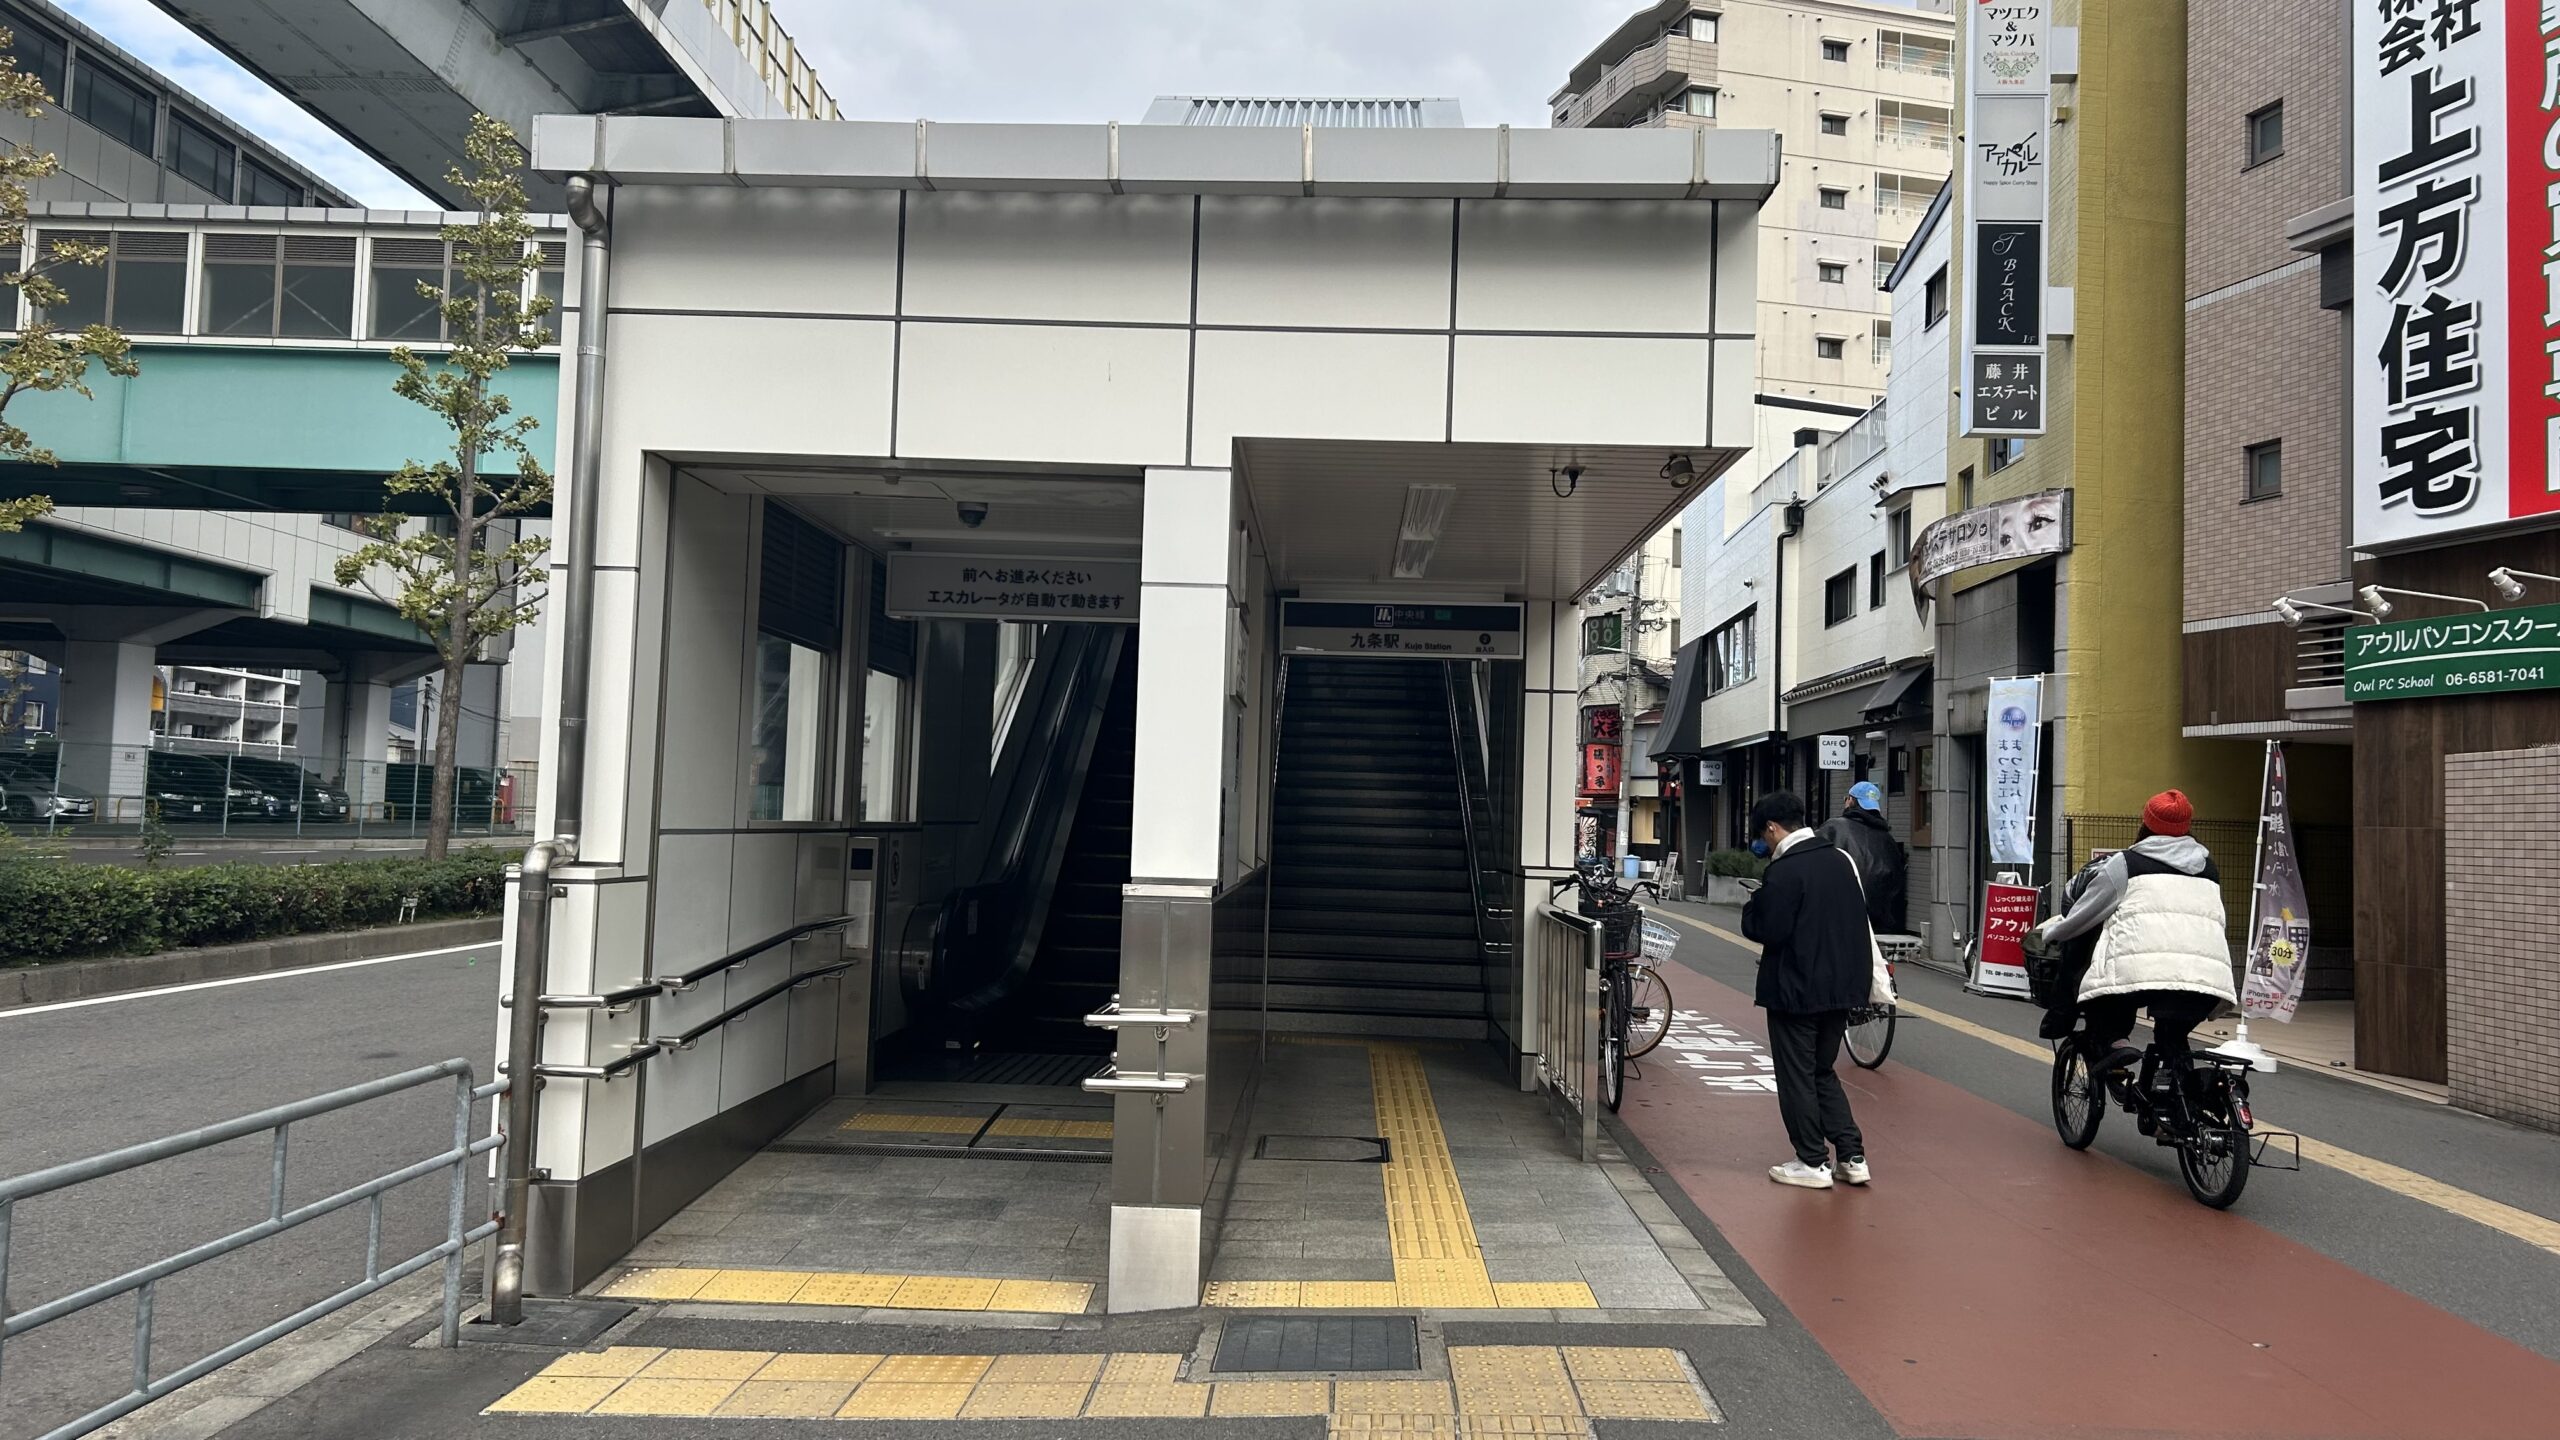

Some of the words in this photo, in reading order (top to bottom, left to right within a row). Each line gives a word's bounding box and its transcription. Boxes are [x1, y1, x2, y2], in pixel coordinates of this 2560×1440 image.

[1984, 6, 2039, 20] マツエク
[2005, 21, 2018, 32] &
[2001, 158, 2042, 176] カレー
[1998, 258, 2017, 333] BLACK
[2377, 67, 2478, 511] 上方住宅
[1976, 384, 2038, 401] エステート
[1985, 405, 2028, 421] ビル
[961, 566, 1092, 585] 前へお進みください
[927, 589, 1125, 611] エスカレータが自動で動きます
[1350, 632, 1399, 650] 九条駅
[2357, 616, 2560, 656] アウルパソコンスクー
[1404, 641, 1422, 651] Kujo
[1424, 642, 1452, 651] Station
[2353, 678, 2374, 692] Owl
[2378, 677, 2394, 690] PC
[2397, 674, 2434, 689] School
[2445, 666, 2545, 686] 06-6581-7041
[1990, 917, 2031, 933] アウル
[2271, 946, 2293, 959] 30分
[2246, 989, 2270, 999] iPhone
